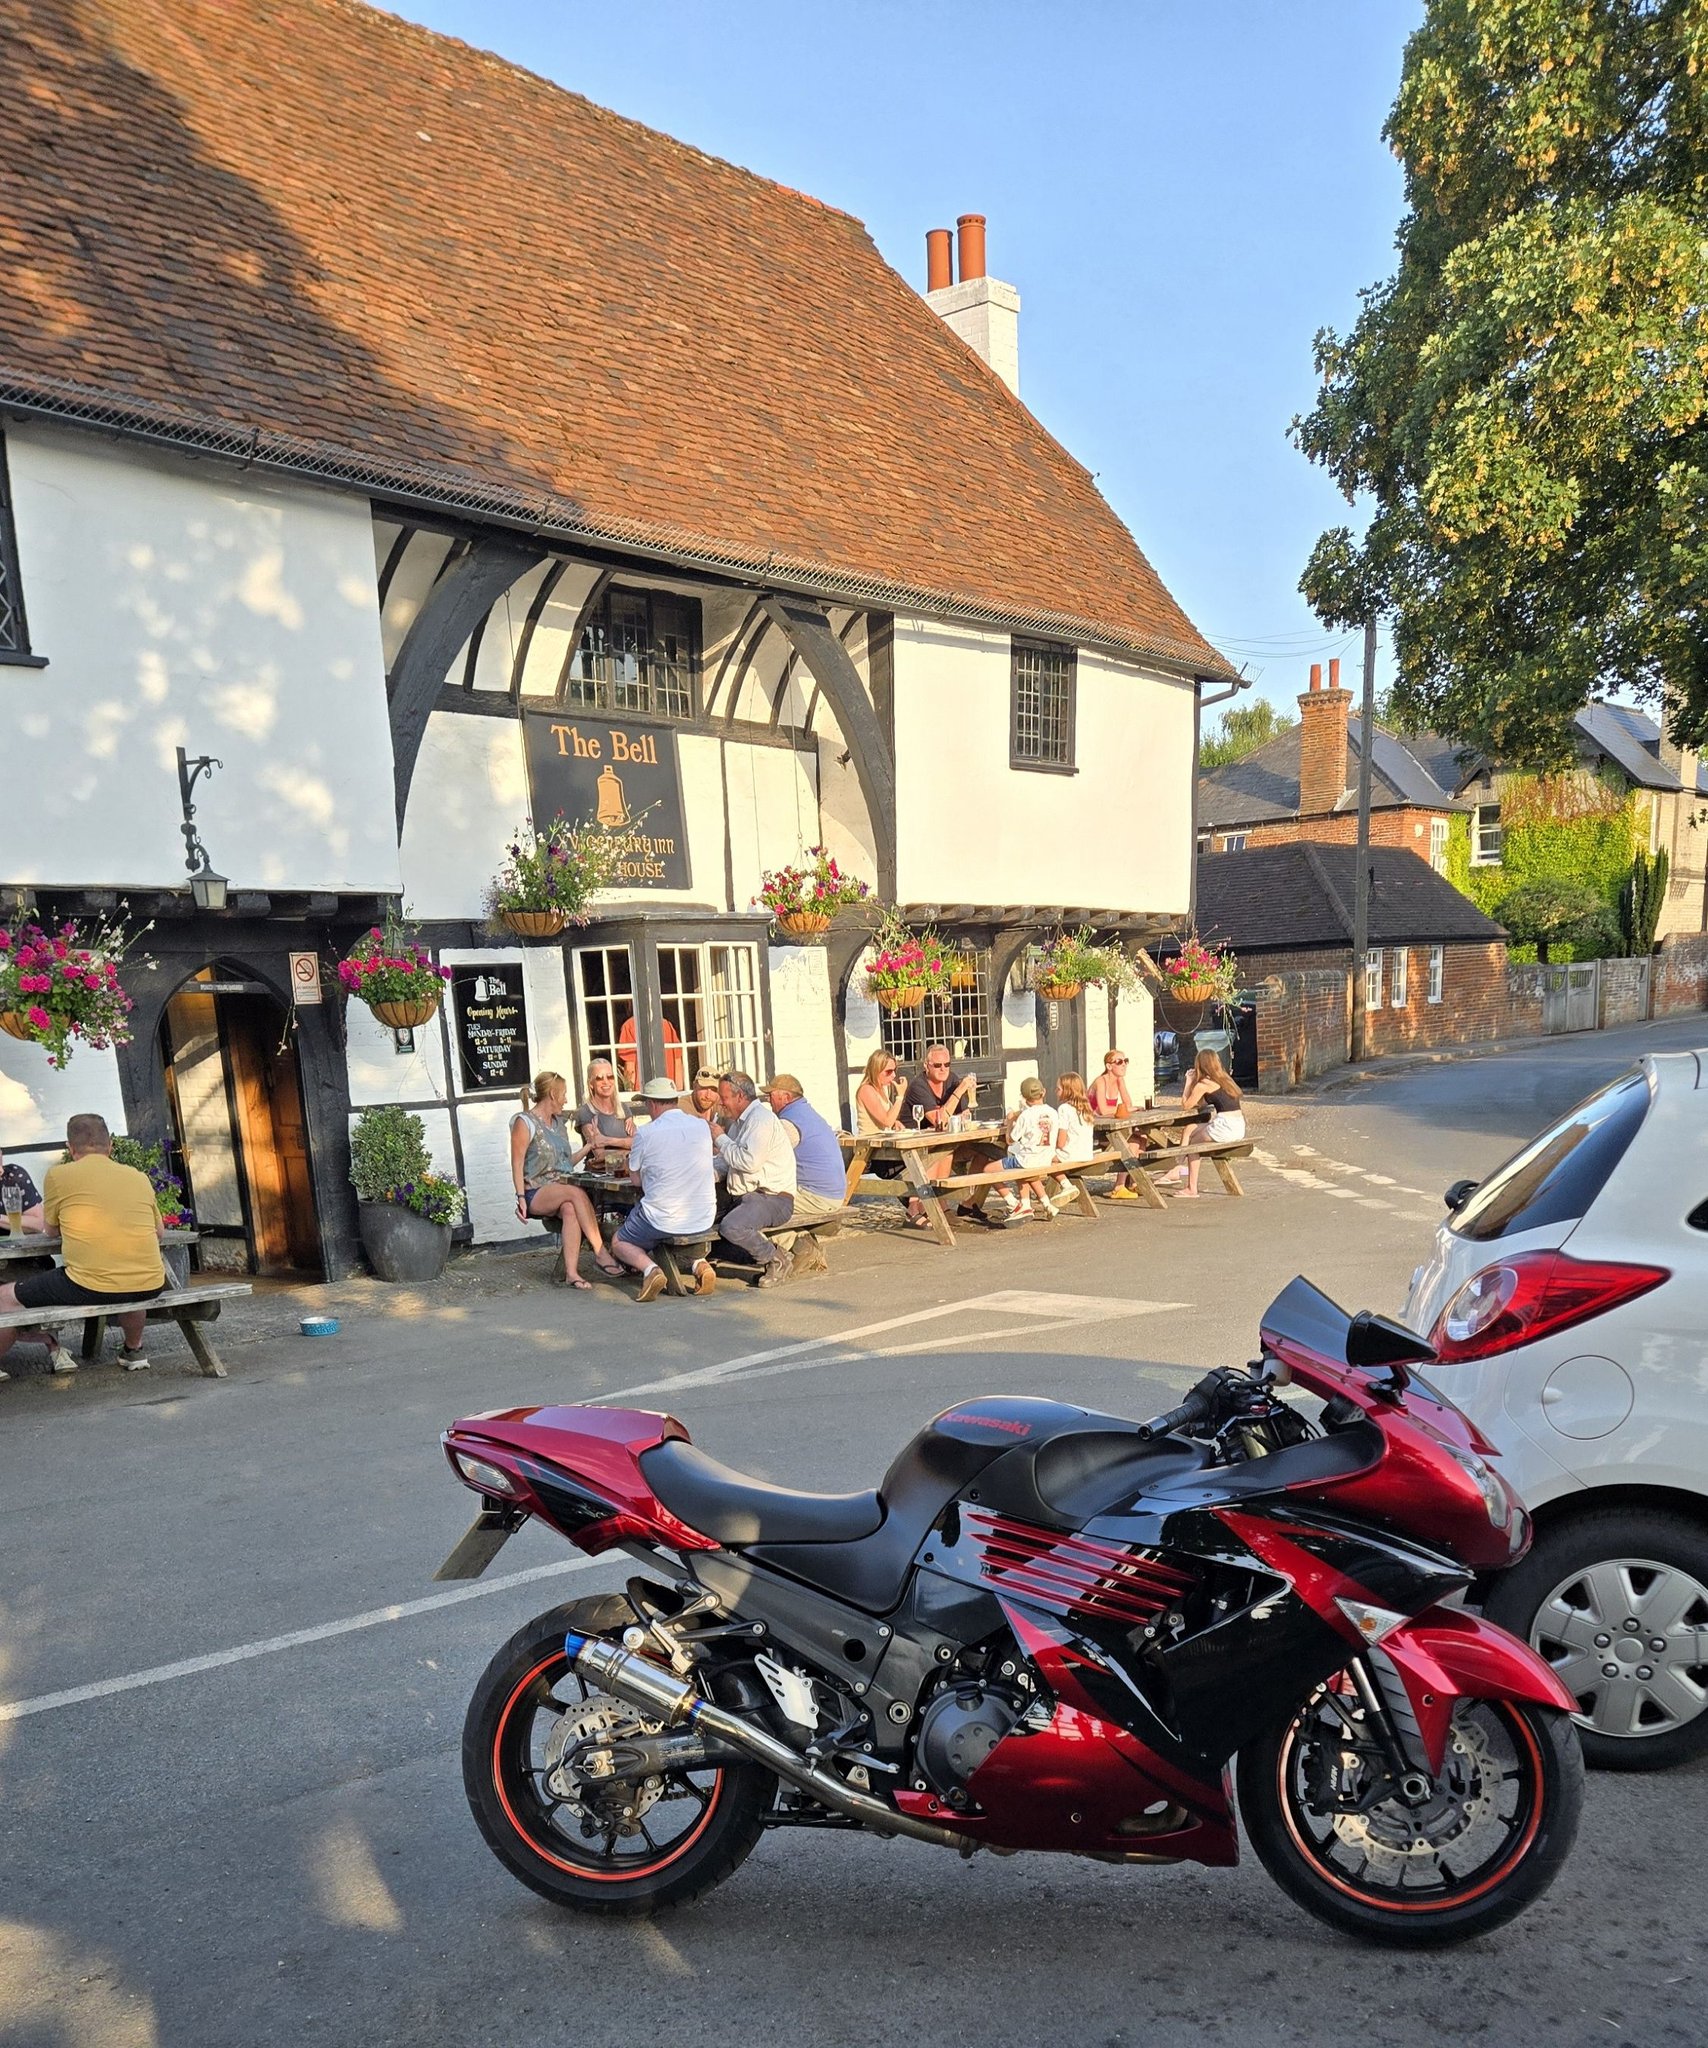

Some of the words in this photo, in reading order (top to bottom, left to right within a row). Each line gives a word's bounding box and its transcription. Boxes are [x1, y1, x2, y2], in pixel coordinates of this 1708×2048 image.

[551, 725, 601, 758] The
[609, 731, 657, 764] Bell
[618, 861, 664, 878] HOUSE
[489, 981, 507, 995] Bell
[467, 1006, 493, 1020] Opening
[496, 1005, 518, 1020] Hours
[477, 1045, 511, 1054] SATURDAY
[483, 1060, 508, 1069] SUNDAY
[940, 1412, 1031, 1437] Kawasaki
